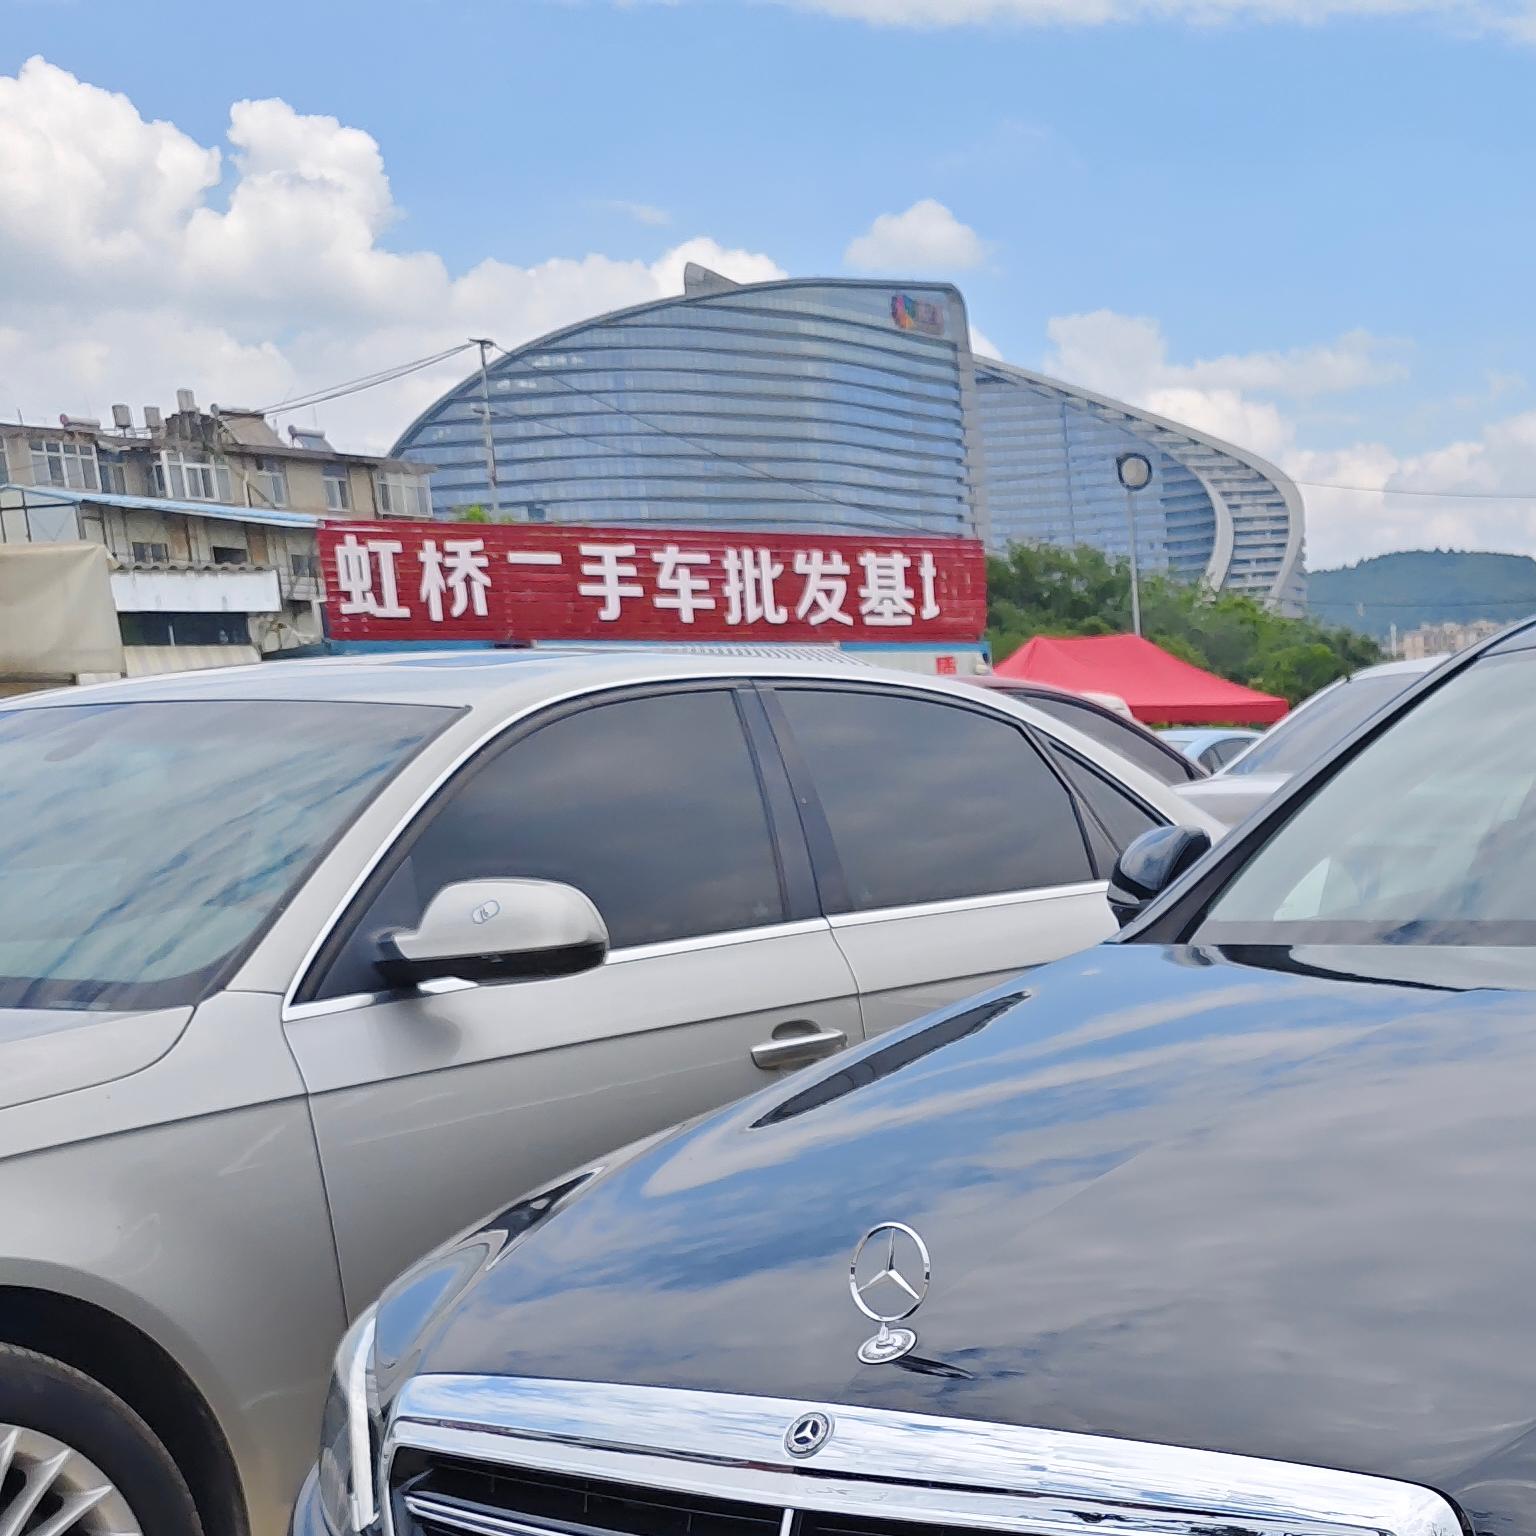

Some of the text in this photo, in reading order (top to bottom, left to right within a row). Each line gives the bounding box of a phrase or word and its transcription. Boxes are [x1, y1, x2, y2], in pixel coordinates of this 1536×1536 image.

[334, 533, 941, 627] 虹桥手车批发基
